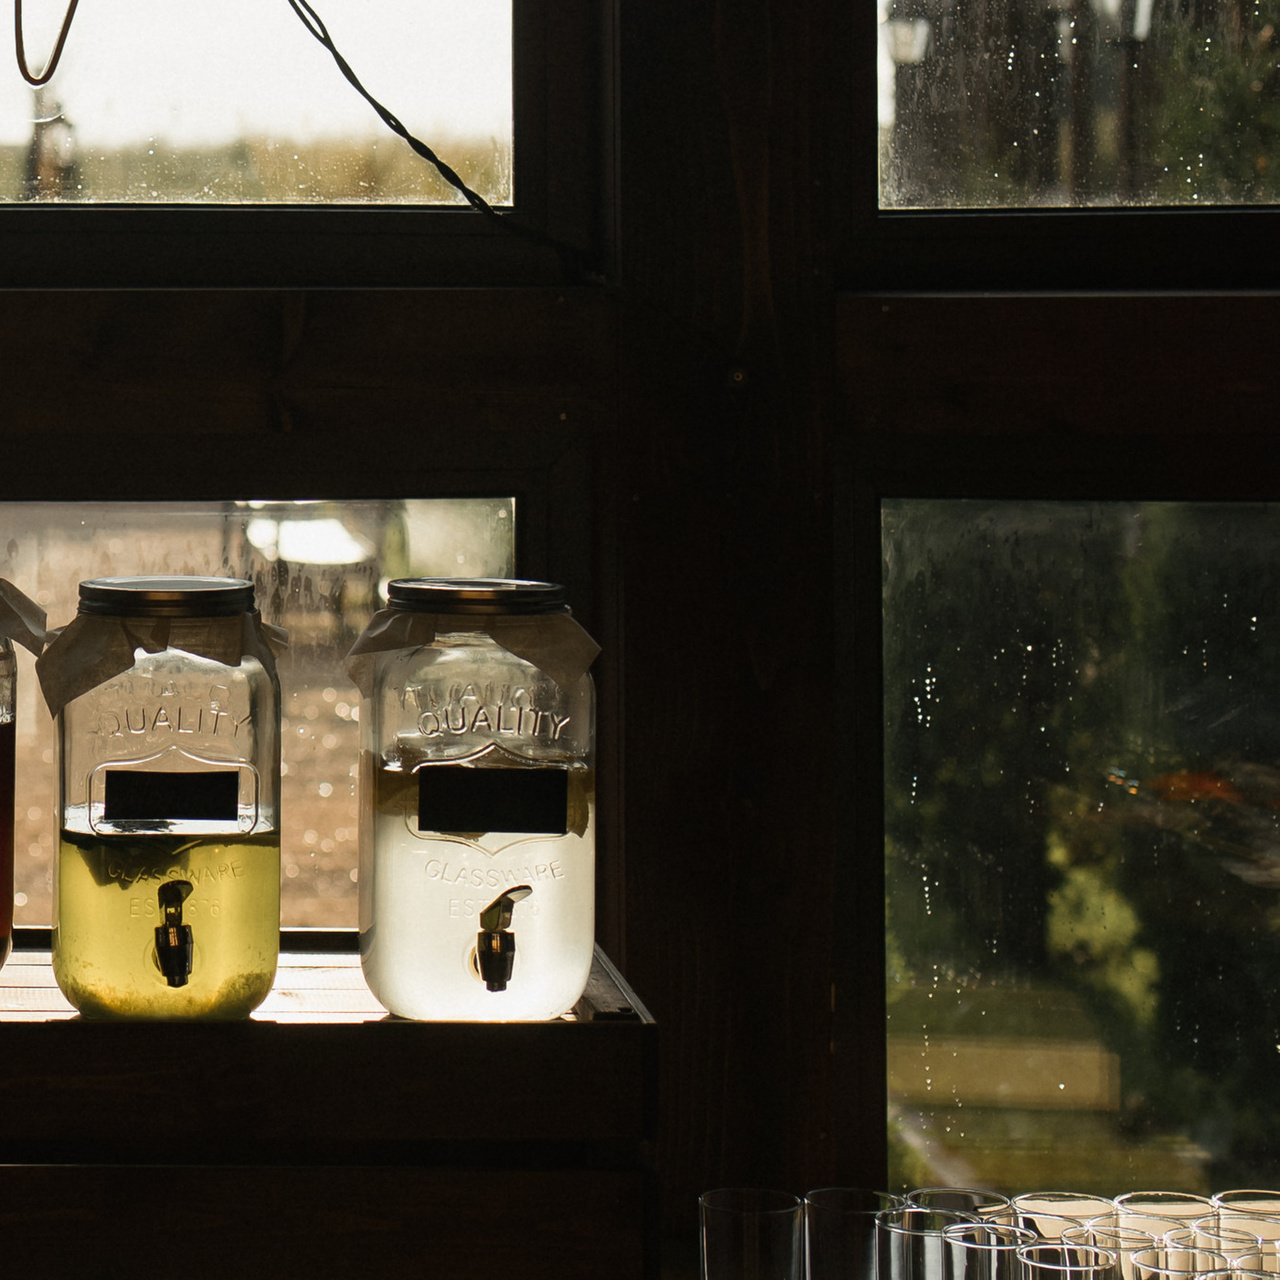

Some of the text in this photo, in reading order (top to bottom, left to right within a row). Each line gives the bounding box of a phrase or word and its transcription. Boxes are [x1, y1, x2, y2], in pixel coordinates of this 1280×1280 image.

[99, 706, 253, 739] QUALITY
[418, 705, 571, 740] QUALITY
[107, 860, 247, 887] GLASSWARE
[424, 858, 566, 889] GLASSWARE
